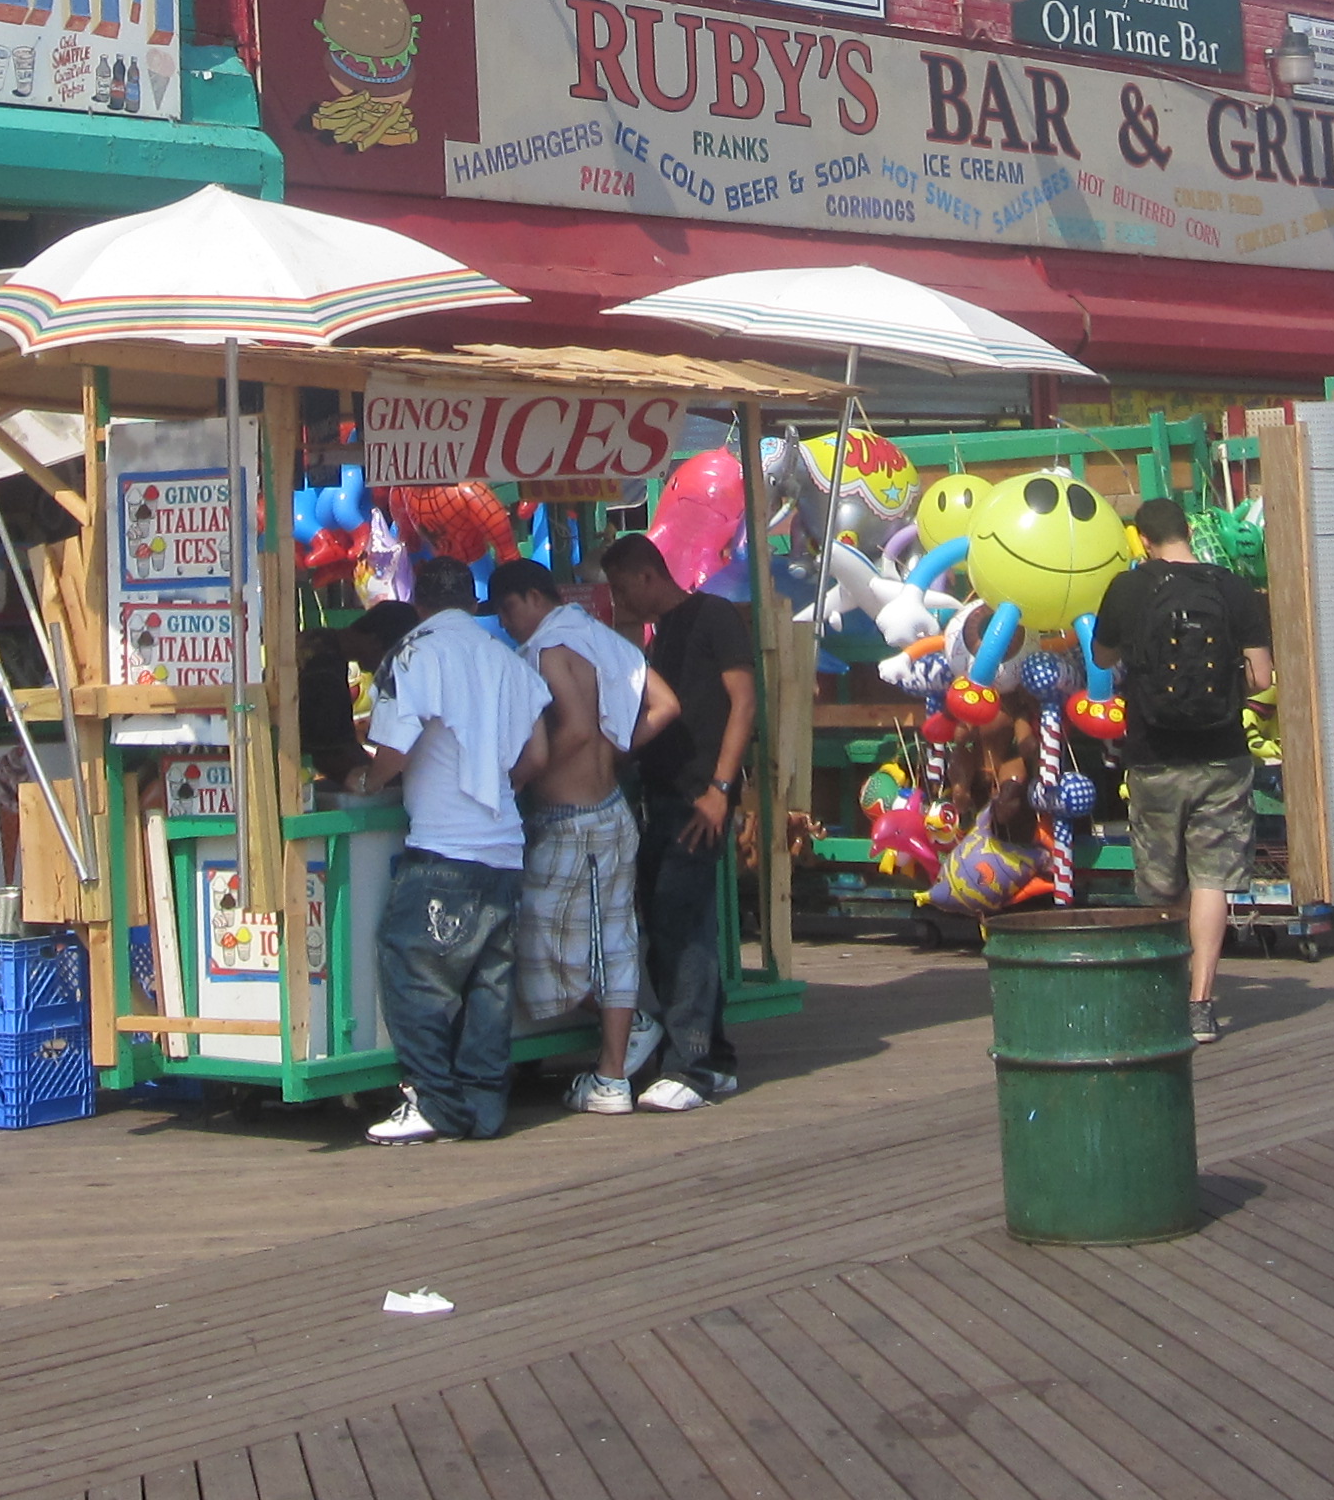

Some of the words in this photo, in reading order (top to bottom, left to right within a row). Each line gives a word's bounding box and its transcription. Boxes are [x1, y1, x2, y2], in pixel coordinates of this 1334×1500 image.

[1041, 0, 1097, 47] Old
[1104, 11, 1171, 60] Time
[1180, 21, 1220, 67] Bar
[920, 50, 1080, 159] BAR
[1118, 81, 1171, 170] &
[452, 120, 603, 184] HAMBURGERS
[692, 130, 770, 163] FRANKS
[579, 166, 636, 198] PIZZA
[614, 121, 650, 163] ICE
[660, 153, 715, 206] COLD
[725, 175, 778, 212] BEER
[787, 169, 805, 195] &
[814, 151, 871, 188] SODA
[923, 152, 951, 178] ICE
[960, 156, 1024, 185] CREAM
[825, 193, 916, 222] CORNDOGS
[881, 155, 920, 195] HOT
[925, 182, 982, 231] SWEET
[991, 167, 1073, 234] SAUSAGES
[1076, 169, 1105, 198] HOT
[1112, 185, 1177, 229] BUTTERED
[1186, 216, 1221, 248] CORN
[366, 396, 473, 432] GINOS
[468, 396, 679, 479] ICES
[366, 441, 465, 482] ITALIAN
[164, 484, 230, 506] GINO'S
[174, 539, 217, 565] ICES
[167, 615, 230, 634] GINO'S
